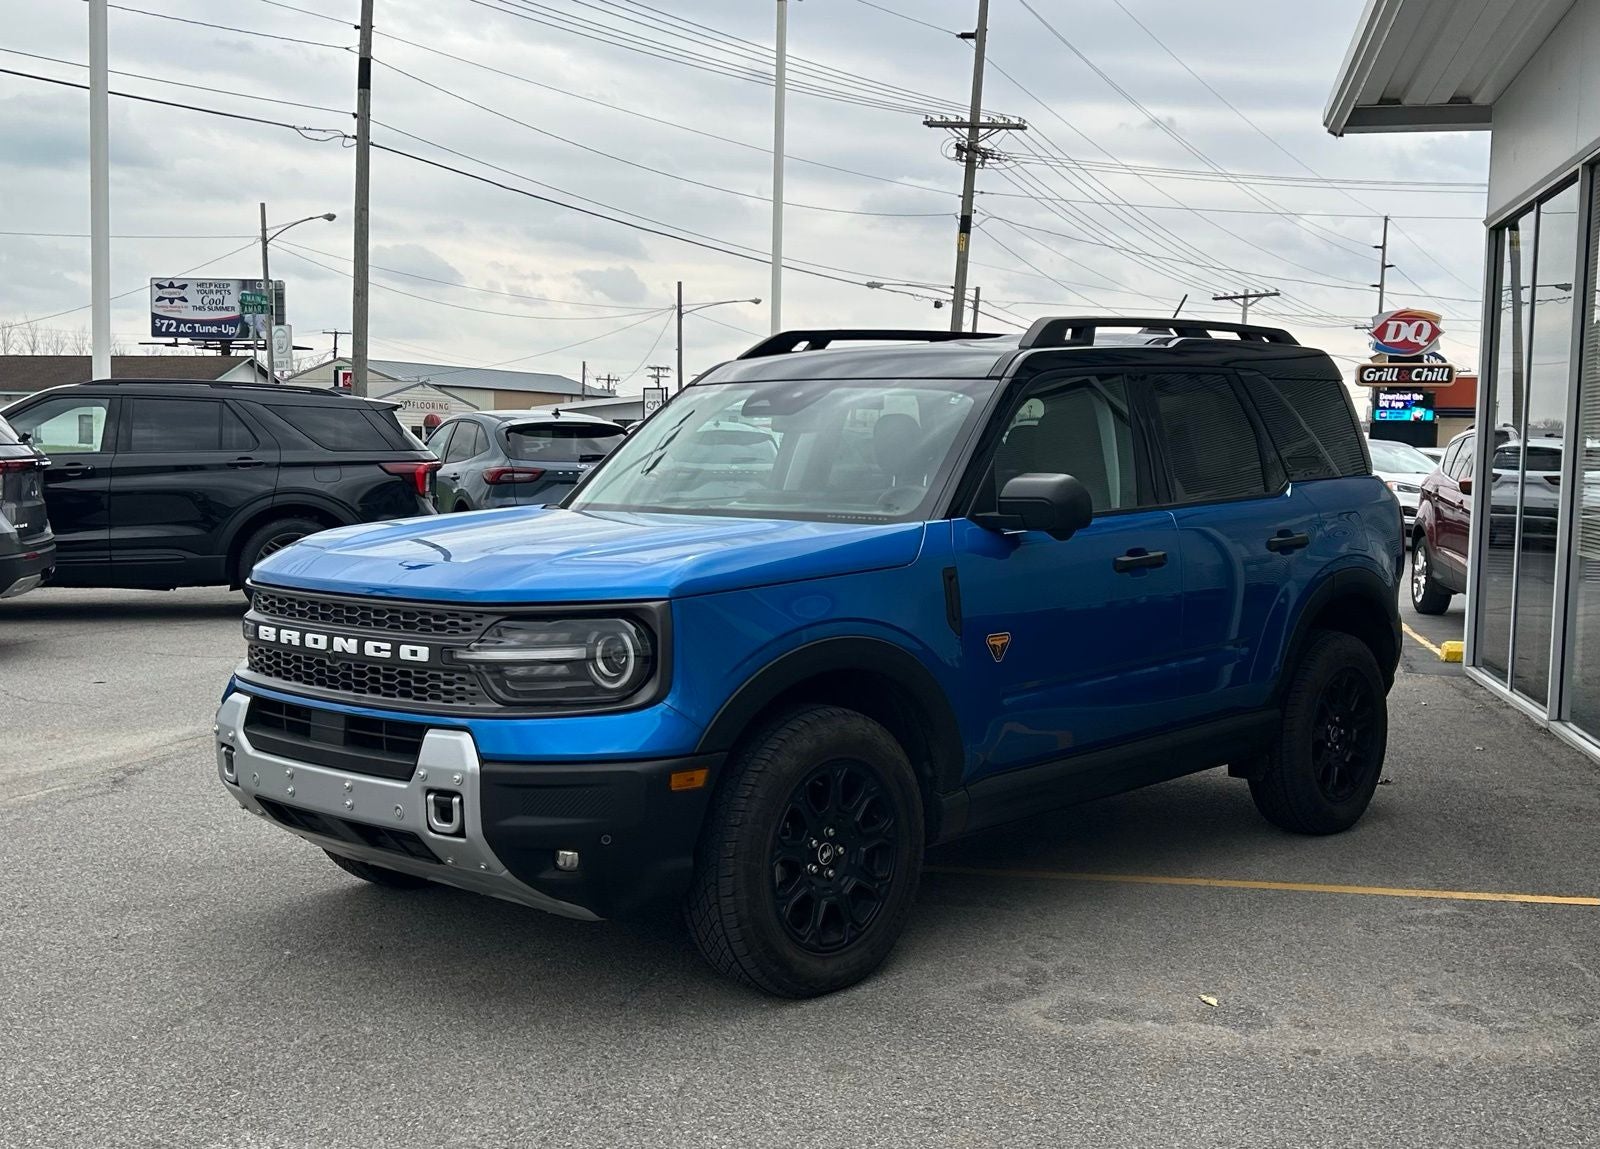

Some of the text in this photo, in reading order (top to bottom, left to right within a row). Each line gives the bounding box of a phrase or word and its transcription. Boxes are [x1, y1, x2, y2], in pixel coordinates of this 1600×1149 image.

[201, 295, 226, 306] Cool
[155, 318, 236, 336] $72 AC Tune-Up
[1383, 320, 1432, 346] DQ
[1363, 367, 1449, 382] Grill & Chill
[1379, 393, 1424, 401] Download the
[412, 401, 449, 411] FLOORING
[1391, 400, 1404, 409] App
[258, 625, 430, 662] BRONCO
